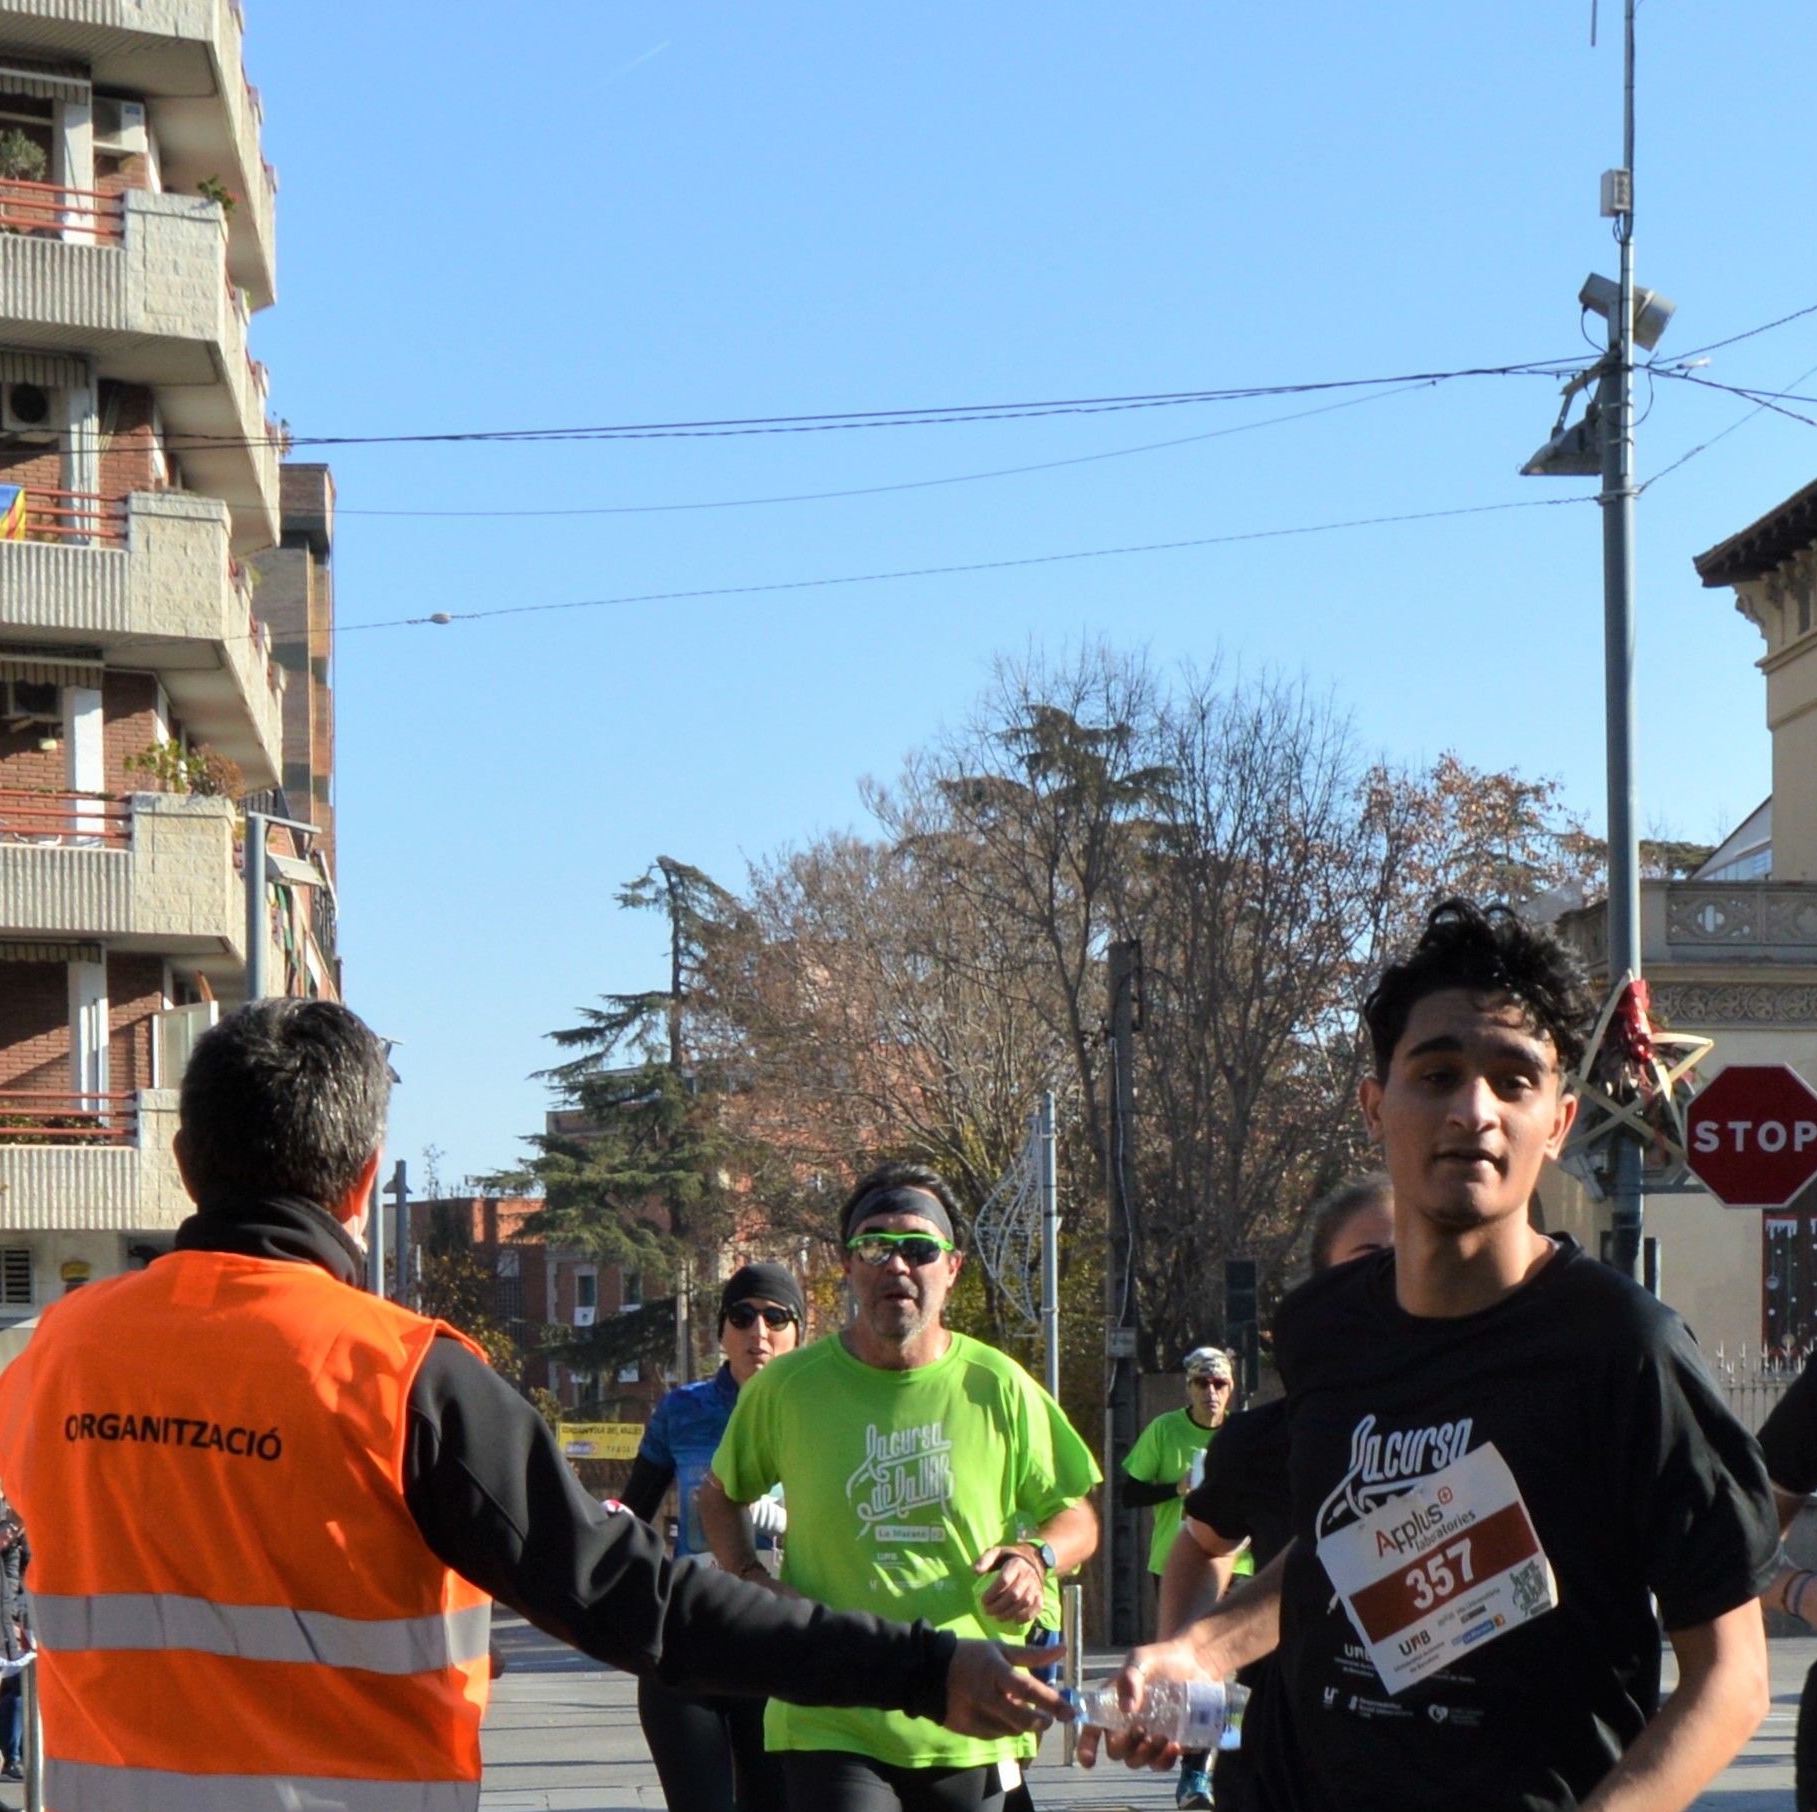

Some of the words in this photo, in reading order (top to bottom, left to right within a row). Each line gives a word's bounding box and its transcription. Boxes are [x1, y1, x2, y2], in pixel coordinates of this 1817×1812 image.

[65, 1412, 282, 1461] ORGANITZACIÓ
[890, 1422, 950, 1458] cursa
[1384, 1418, 1472, 1476] cursa
[1414, 1509, 1477, 1553] laboratories
[1405, 1537, 1474, 1610] 357
[1398, 1629, 1432, 1656] UAB
